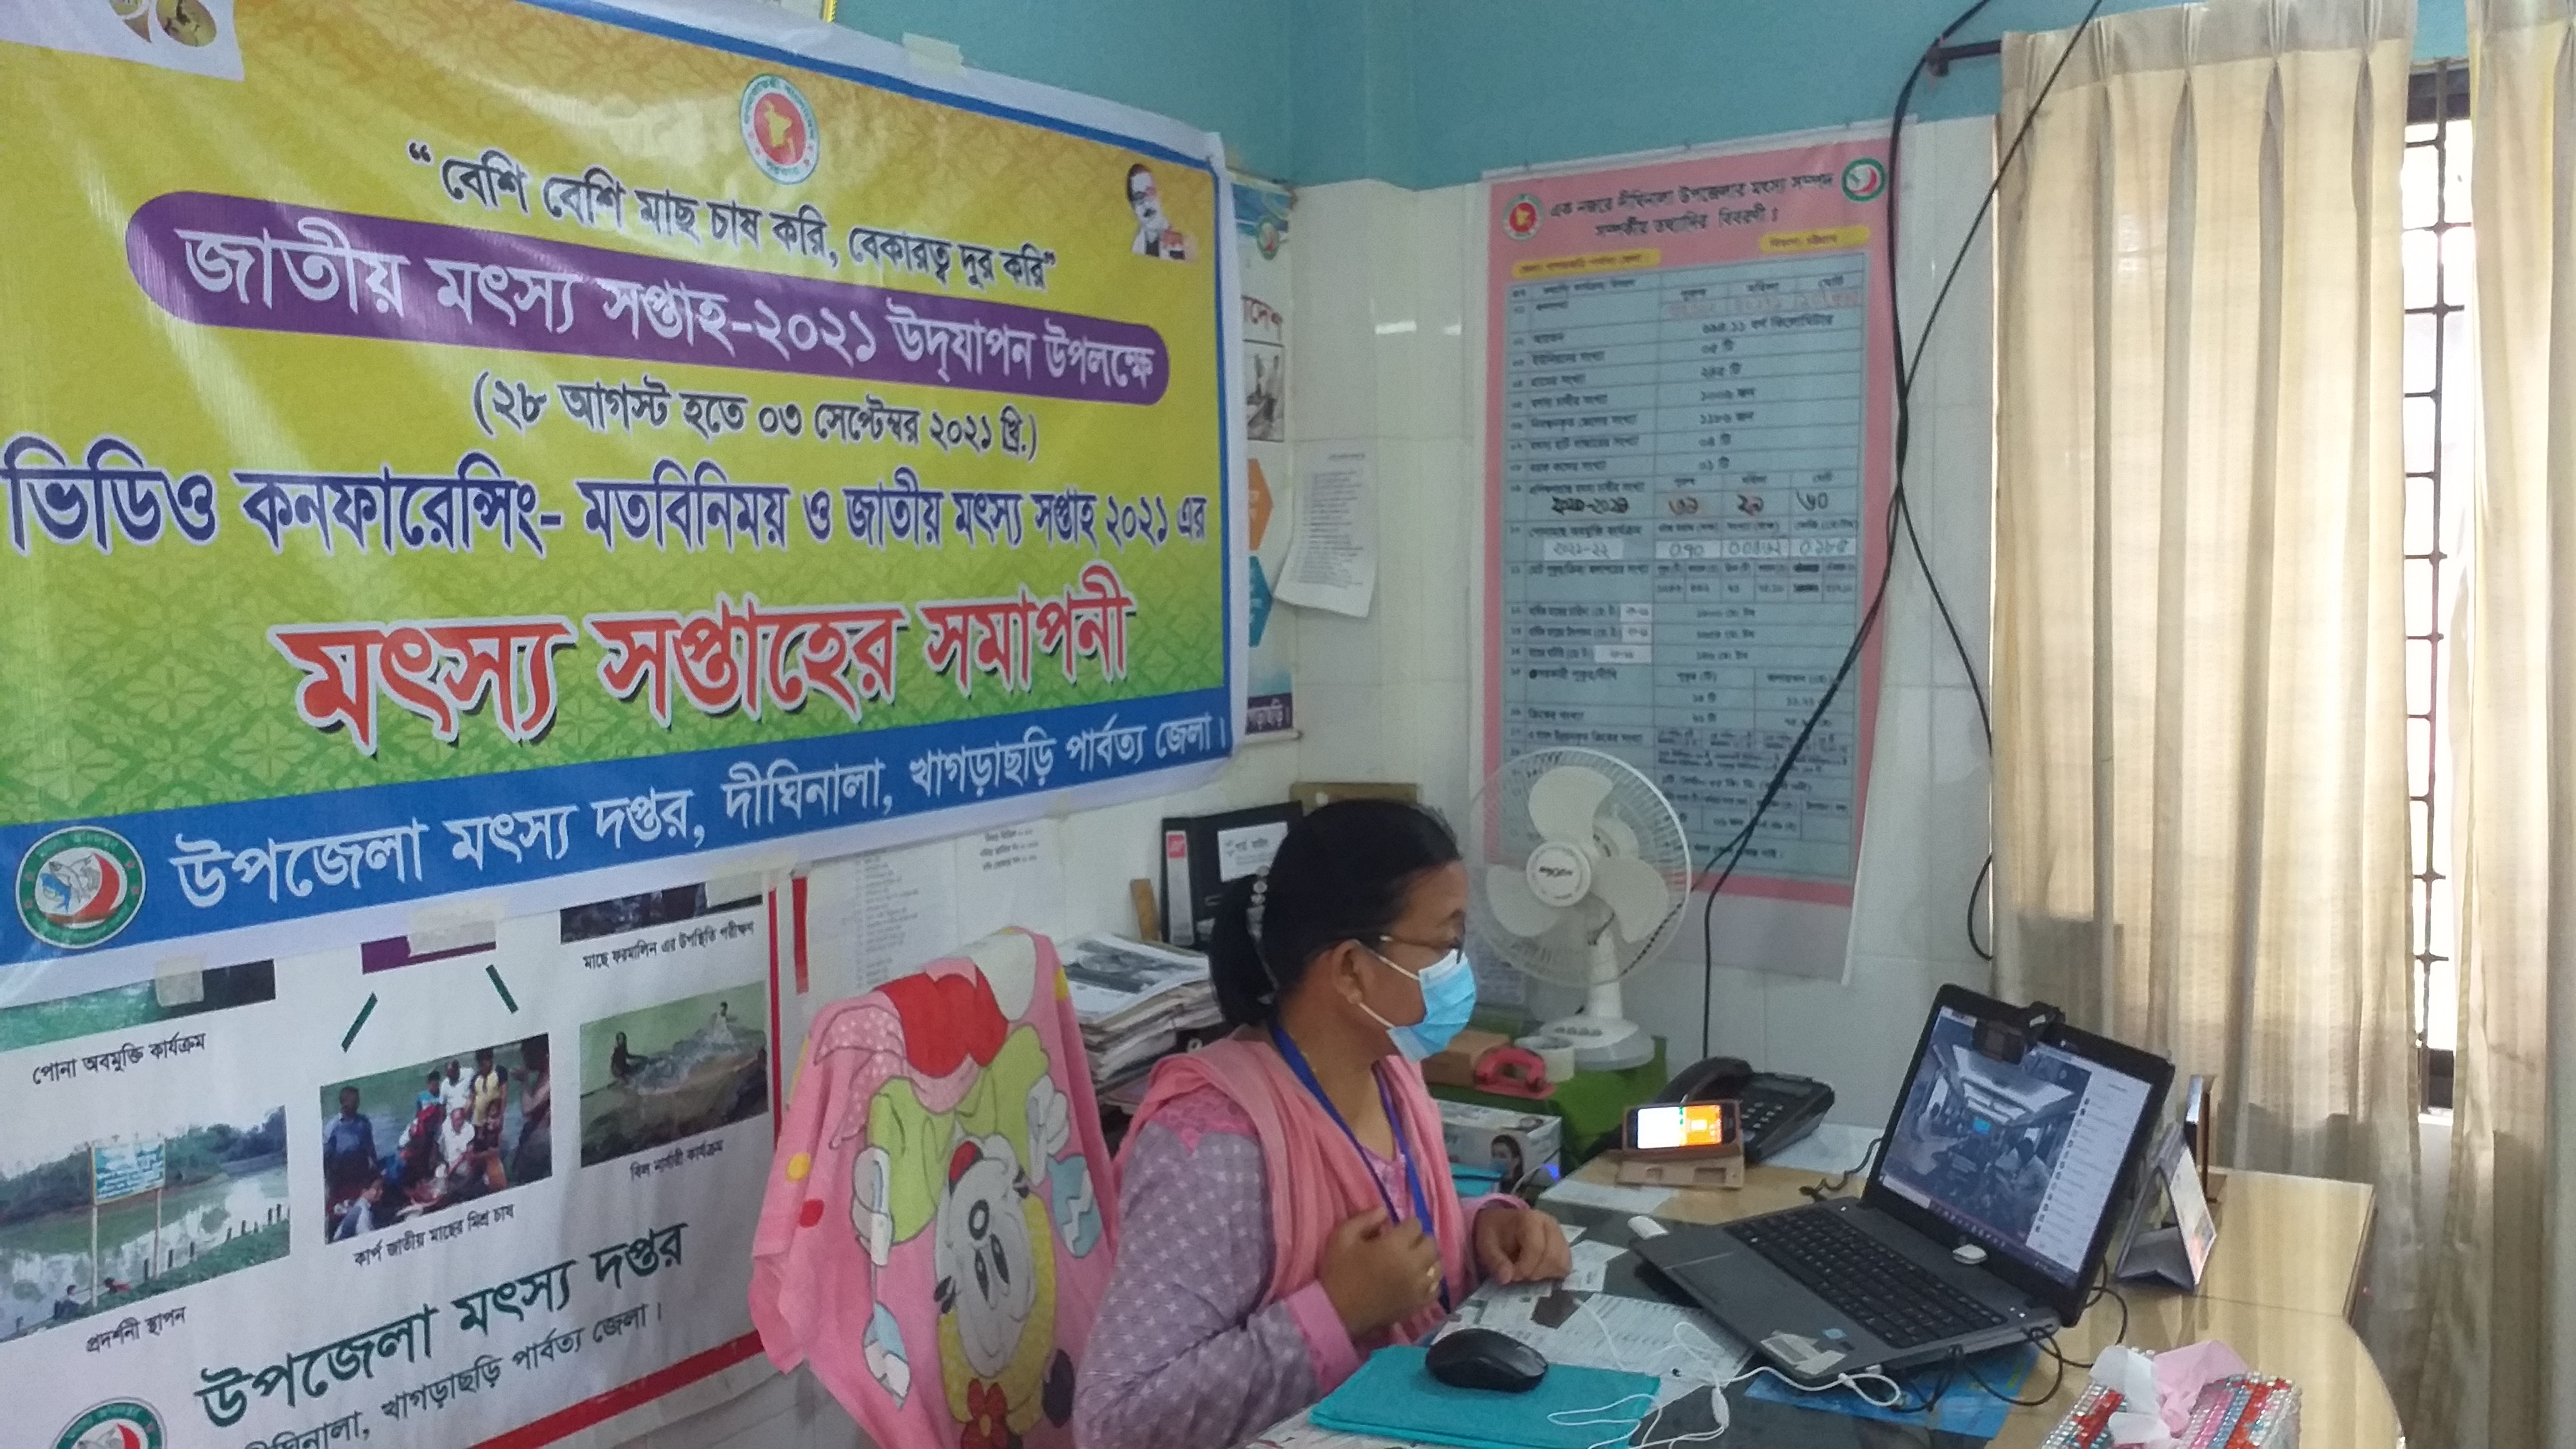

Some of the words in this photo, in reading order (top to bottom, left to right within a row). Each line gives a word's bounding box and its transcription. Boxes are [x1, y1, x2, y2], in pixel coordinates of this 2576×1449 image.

[542, 167, 626, 227] বেশি
[635, 190, 700, 242] মাছ
[707, 200, 762, 245] চাষ
[769, 205, 837, 267] করি,
[175, 218, 409, 316] জাতীয়
[425, 258, 582, 334] মৎস্য
[596, 278, 876, 367] সপ্তাহ-২০২১
[1042, 318, 1154, 389] উপলক্ষে
[557, 375, 671, 430] আগস্ট
[679, 393, 748, 438] হতে
[759, 404, 802, 436] ০৩
[815, 394, 921, 444] সেপ্টেম্বর
[930, 410, 992, 453] ২০২১
[0, 435, 216, 551] ভিডিও
[577, 460, 789, 550] মতবিনিময়
[803, 491, 831, 541] ও
[843, 468, 944, 547] জাতীয়
[953, 492, 1023, 546] মৎস্য
[1030, 487, 1097, 553] সপ্তাহ
[1106, 495, 1168, 547] ২০২১
[1178, 497, 1207, 539] এর
[273, 619, 575, 751] মৎস্য
[588, 597, 907, 726] সপ্তাহের
[920, 562, 1134, 696] সমাপনী
[170, 818, 429, 909] উপজেলা
[446, 806, 578, 871] মৎস্য
[593, 786, 705, 849] দপ্তর,
[722, 758, 892, 829] দীঘিনালা,
[909, 726, 1057, 799] খাগড়াছড়ি
[1066, 714, 1147, 772] পার্বত্য
[582, 952, 610, 969] মাছে
[612, 939, 657, 963] ফরমালিন
[661, 937, 676, 952] এর
[678, 924, 717, 949] উপস্থিতি
[32, 1058, 78, 1085] পোনা
[82, 1042, 144, 1072] অবমুক্তি
[149, 1032, 207, 1059] কার্যক্রম
[630, 1161, 650, 1181] বিল
[686, 1139, 724, 1161] কার্যক্রম
[353, 1238, 383, 1267] কার্প
[386, 1229, 425, 1256] জাতীয়
[429, 1219, 464, 1241] মাছের
[467, 1209, 490, 1231] মিশ্র
[494, 1203, 514, 1223] চাষ
[86, 1317, 141, 1353] প্রদর্শনী
[144, 1306, 186, 1336] স্থাপন
[194, 1303, 439, 1427] উপজেলা
[451, 1259, 578, 1335] মৎস্য
[588, 1222, 688, 1289] দপ্তর
[381, 1354, 504, 1421] খাগড়াছড়ি
[512, 1327, 585, 1370] পার্বত্য
